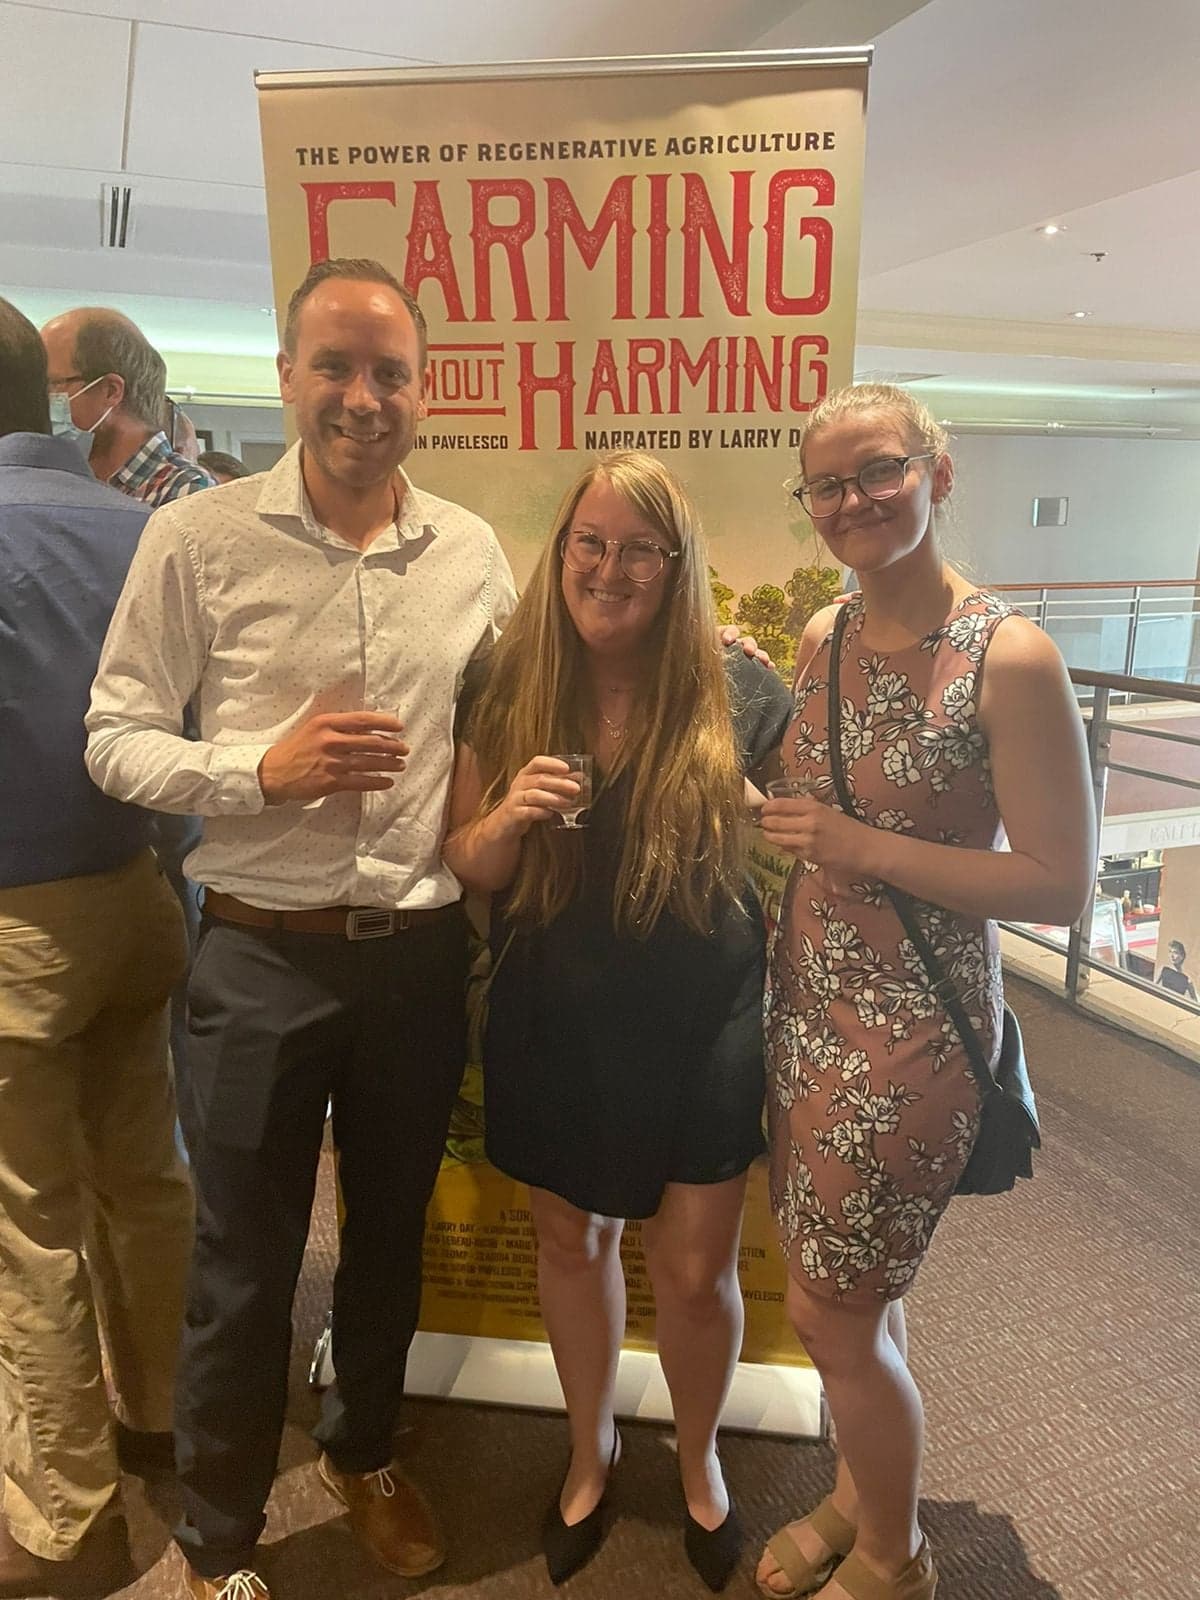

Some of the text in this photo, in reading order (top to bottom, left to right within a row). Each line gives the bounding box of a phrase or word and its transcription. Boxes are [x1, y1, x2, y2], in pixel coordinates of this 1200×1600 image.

[296, 131, 836, 166] THE POWER OF REGENERATIVE AGRICULTURE
[515, 334, 829, 450] HARMING
[432, 435, 508, 450] PAVELESCO
[585, 428, 801, 450] NARRATED BY LARRY D
